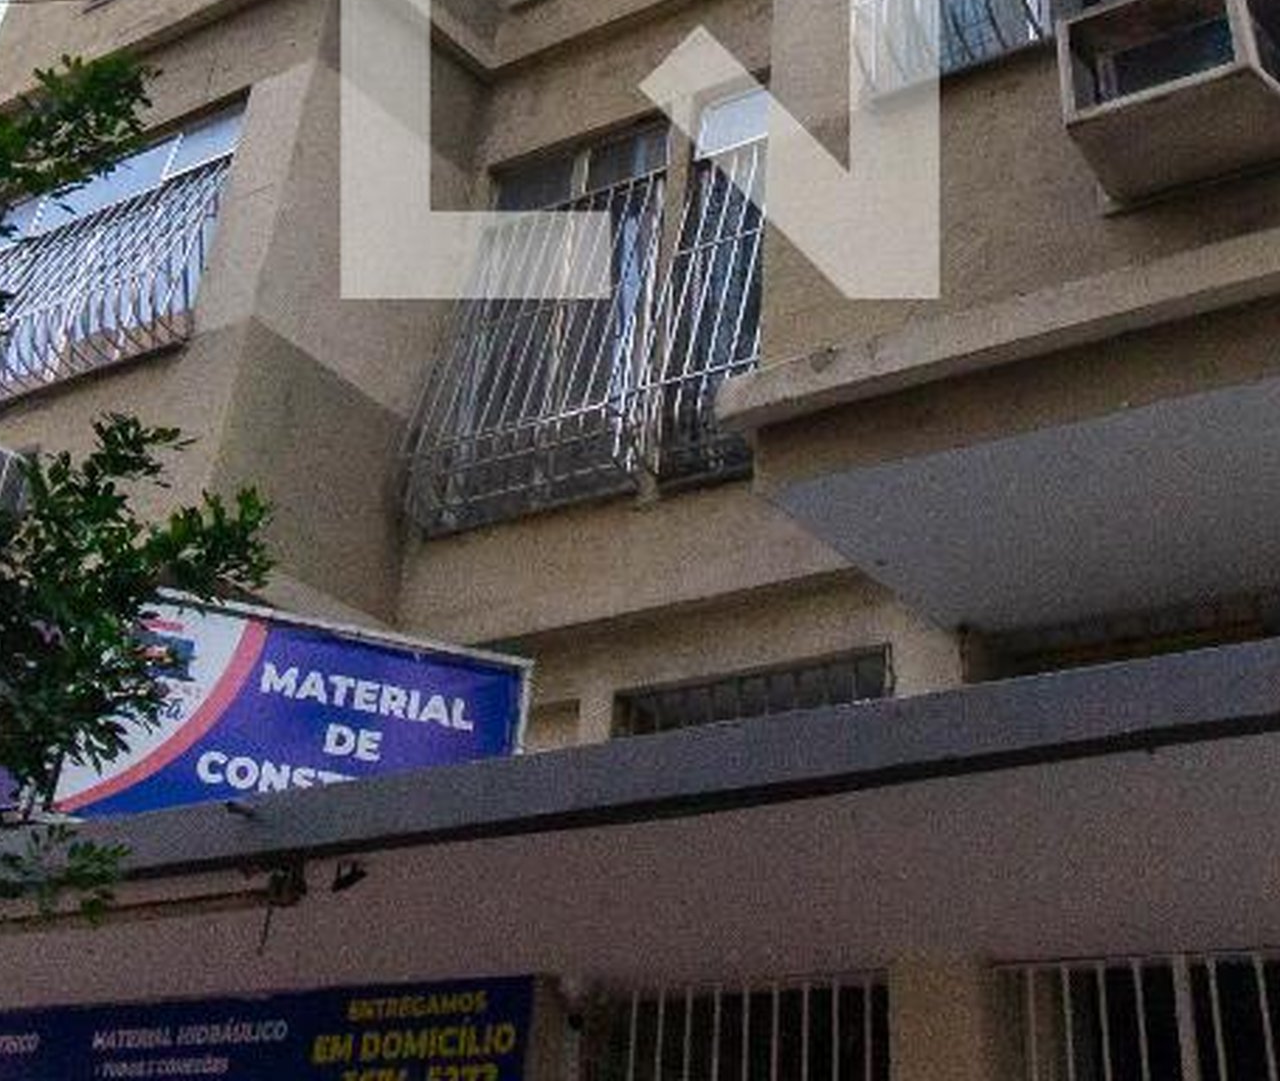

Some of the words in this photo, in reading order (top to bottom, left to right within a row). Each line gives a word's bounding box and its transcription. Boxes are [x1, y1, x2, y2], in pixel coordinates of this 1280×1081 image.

[260, 663, 473, 732] MATERIAL
[323, 723, 382, 762] DE
[196, 751, 358, 793] CONS
[347, 990, 488, 1022] ENTREGAMOS
[92, 1027, 172, 1050] MATERIAL
[312, 1032, 353, 1064] EM
[359, 1017, 517, 1063] DOMICÍLIO
